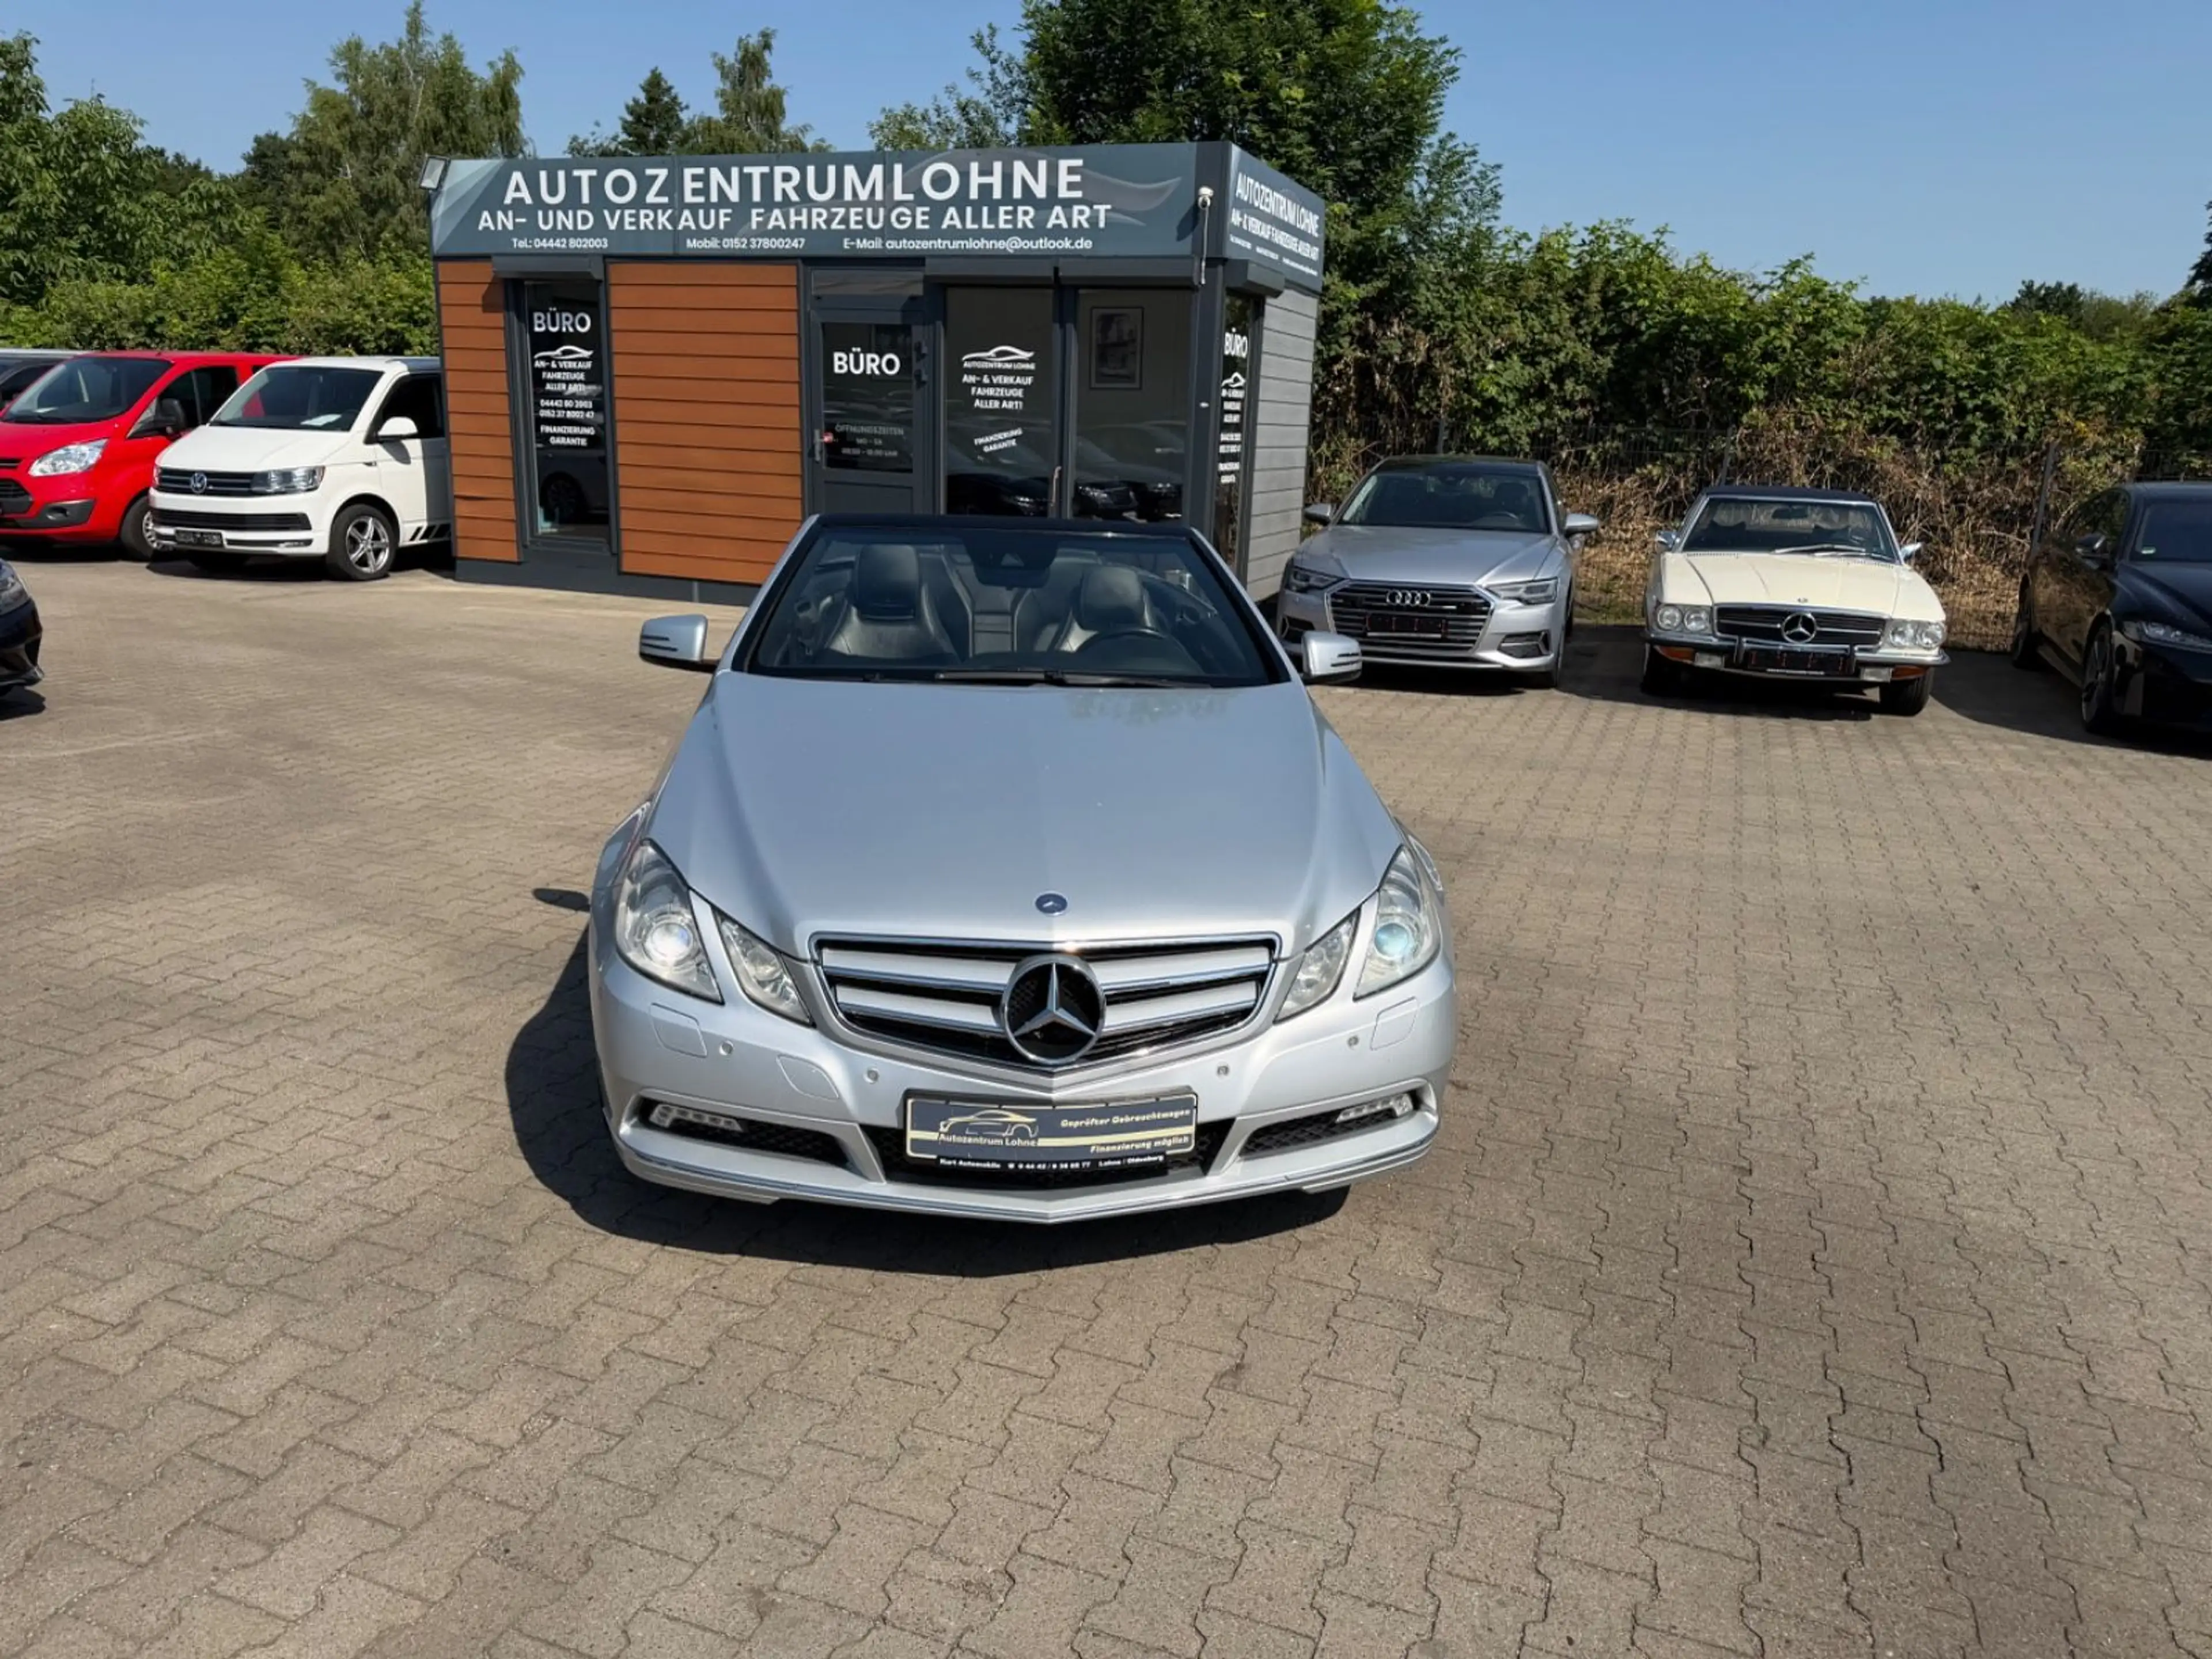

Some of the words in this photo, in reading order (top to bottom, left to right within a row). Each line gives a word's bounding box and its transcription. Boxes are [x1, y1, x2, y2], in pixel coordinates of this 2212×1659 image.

[478, 210, 527, 231] AN-
[537, 209, 594, 231] UND
[603, 208, 732, 231] VERKAUF
[751, 206, 930, 230] FAHRZEUGE
[941, 205, 1036, 230] ALLER
[1046, 204, 1112, 229] ART
[533, 237, 566, 249] 04442
[569, 237, 608, 249] 802003
[685, 237, 719, 249] Mobil:
[722, 238, 747, 249] 0152
[749, 237, 805, 249] 37800247
[843, 237, 882, 249] E-Mail:
[885, 236, 1093, 253] autozentrumlohne@outlook.de
[533, 306, 592, 333] BÜRO
[1224, 327, 1248, 358] BÜRO
[551, 360, 557, 369] &
[558, 360, 593, 370] VERKAUF
[833, 347, 901, 376] BÜRO
[542, 371, 586, 381] FAHRZEUGE
[962, 373, 980, 384] AN-
[982, 374, 990, 384] &
[991, 374, 1034, 385] VERKAUF
[545, 382, 566, 391] ALLER
[971, 387, 1025, 398] FAHRZEUGE
[974, 399, 1001, 409] ALLER
[540, 424, 596, 435] FINANZIERUNG
[939, 1132, 1003, 1146] Autozentrum
[1005, 1135, 1037, 1147] Lohne
[1090, 1141, 1152, 1154] Finanzierung
[1154, 1135, 1190, 1148] möglich
